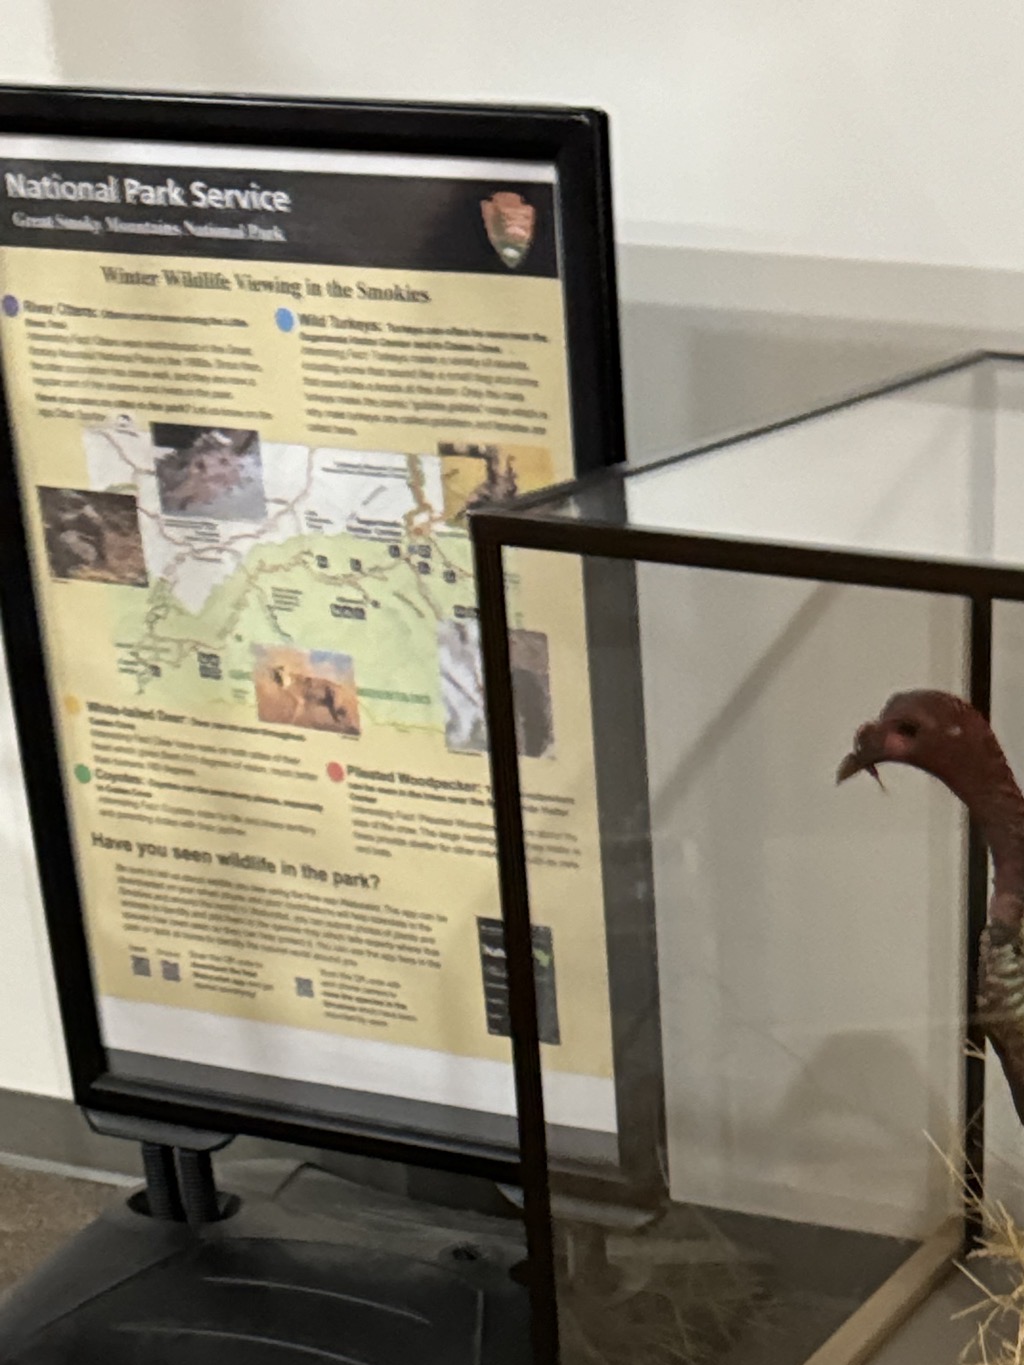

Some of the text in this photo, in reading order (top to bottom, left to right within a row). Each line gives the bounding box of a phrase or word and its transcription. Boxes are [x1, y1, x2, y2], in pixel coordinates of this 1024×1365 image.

[4, 172, 292, 213] National Park Service
[105, 216, 182, 237] Mountains
[183, 220, 247, 239] National
[248, 223, 287, 242] Park
[100, 265, 432, 303] Winter Wildlife Viewing in the Smokies
[91, 831, 381, 890] Have you seen wildlife in the park?
